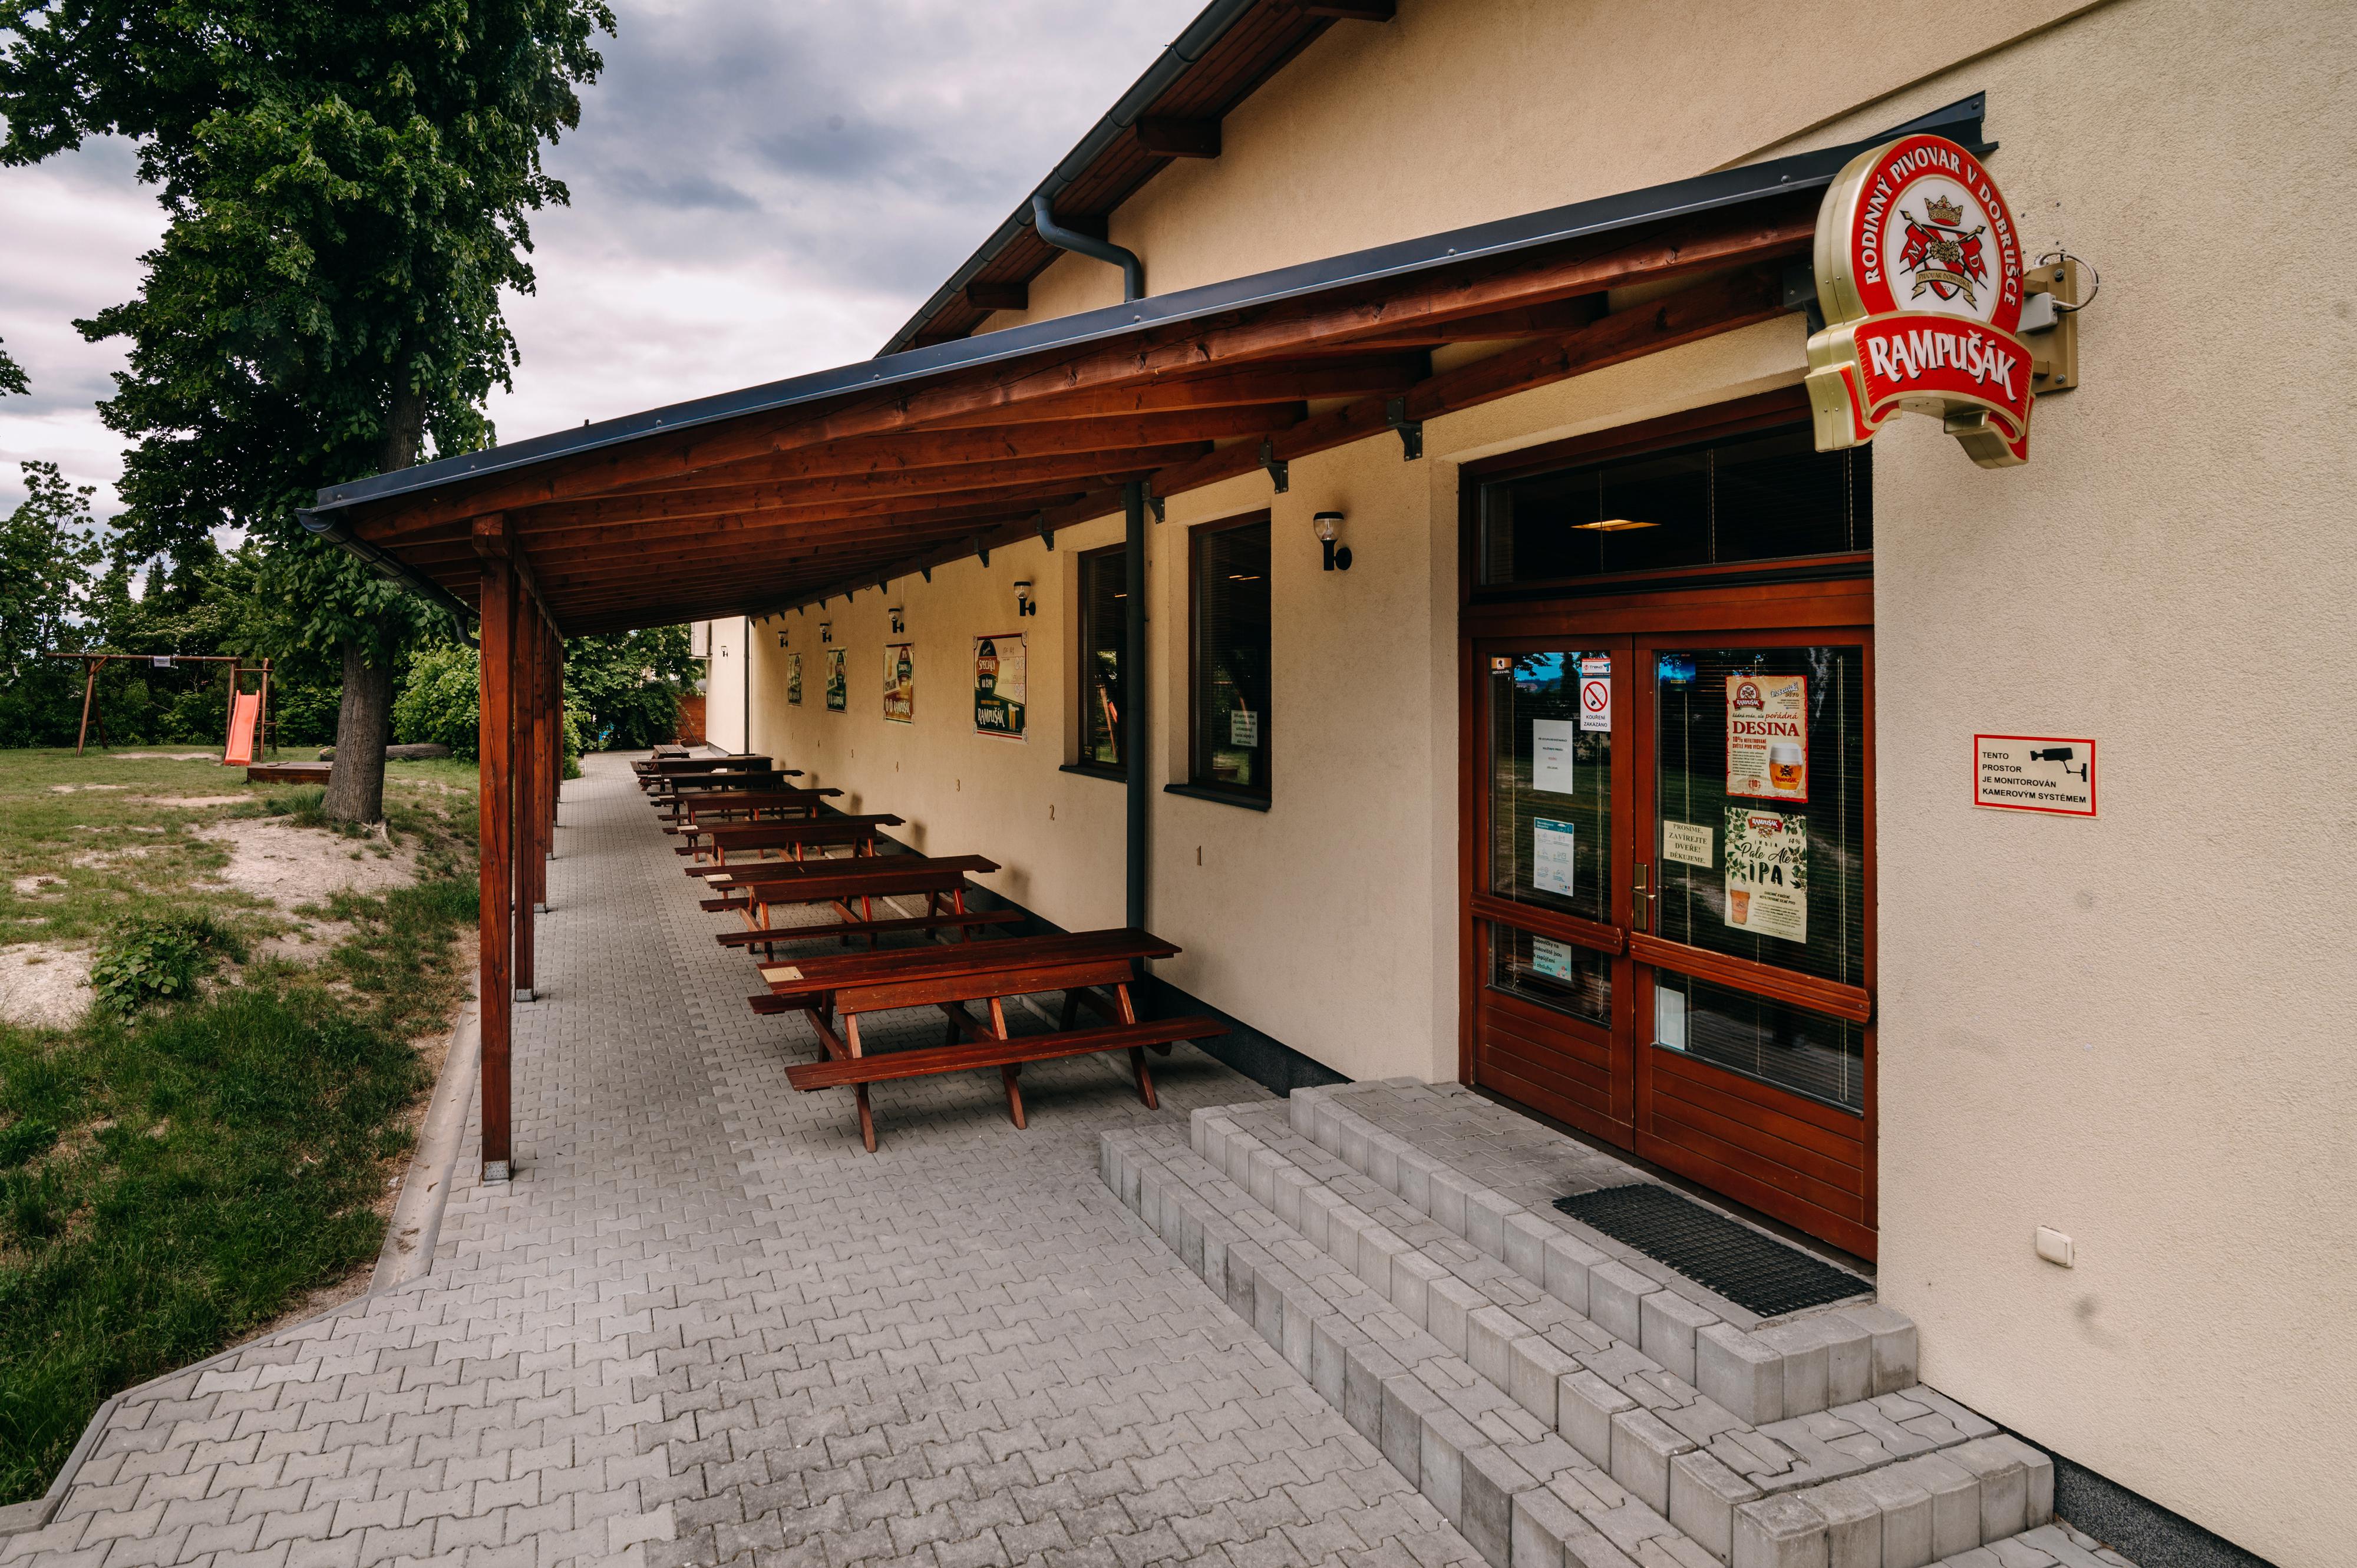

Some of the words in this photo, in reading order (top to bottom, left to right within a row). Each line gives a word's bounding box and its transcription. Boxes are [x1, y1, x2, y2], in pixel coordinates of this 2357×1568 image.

[1861, 171, 1893, 285] RODINNÝ
[1889, 146, 1961, 184] PIVOVAR
[1967, 164, 1978, 184] V
[1979, 183, 2021, 307] DOBRUŠCE
[1907, 240, 1922, 260] M
[1969, 254, 1980, 268] D
[1866, 329, 2018, 402] RAMPUŠÁK
[979, 658, 996, 672] SPECIÁLY
[978, 707, 1005, 728] RAMPUŠÁK
[1764, 711, 1799, 722] pořádná
[1732, 721, 1800, 737] DESINA
[1982, 751, 2009, 760] TENTO
[1982, 764, 2022, 773] PROSTOR
[956, 779, 960, 792] 3
[1993, 777, 2056, 788] MONITOROVÁN
[1982, 788, 2036, 799] KAMEROVÝM
[2038, 793, 2087, 803] SYSTÉMEM
[1049, 804, 1055, 821] 2
[1752, 818, 1778, 828] RAMPUŠÁK
[1669, 832, 1708, 845] ZAVÍREJTE
[1754, 840, 1778, 848] INDIA
[1675, 843, 1701, 853] DVEŘE!
[1741, 841, 1765, 860] Pale
[1768, 847, 1792, 864] Ale
[1196, 845, 1202, 866] 1
[1670, 851, 1706, 864] DĚKUJEME.
